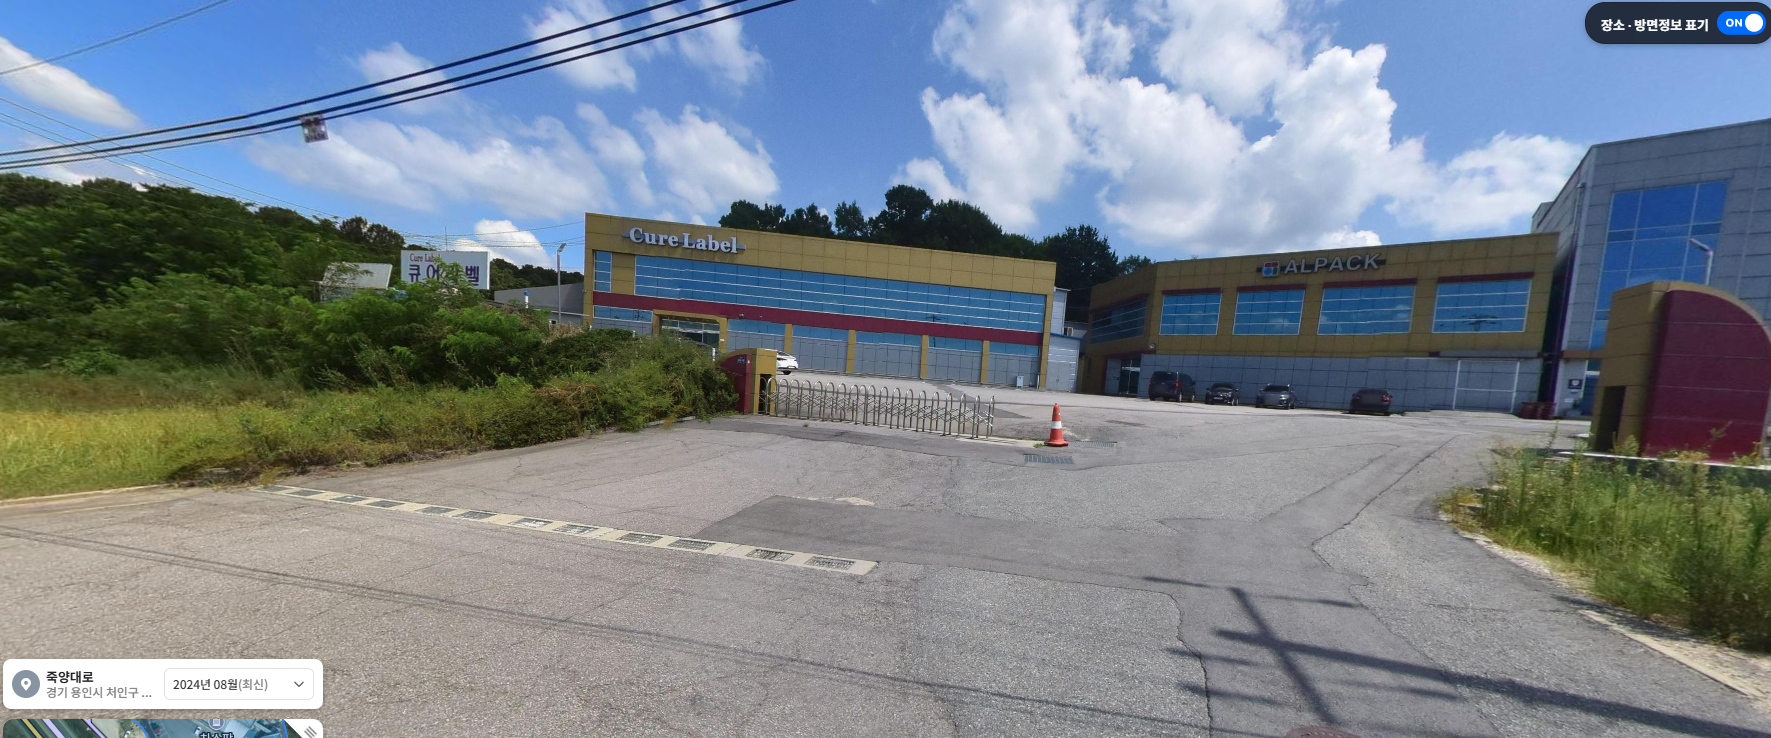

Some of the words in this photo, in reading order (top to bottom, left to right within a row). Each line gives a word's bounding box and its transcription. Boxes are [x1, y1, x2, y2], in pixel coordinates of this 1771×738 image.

[629, 227, 679, 247] Cure
[682, 232, 738, 254] Label
[410, 253, 423, 262] Cure
[1284, 253, 1381, 274] ALPACK
[408, 264, 479, 286] 큐어벨
